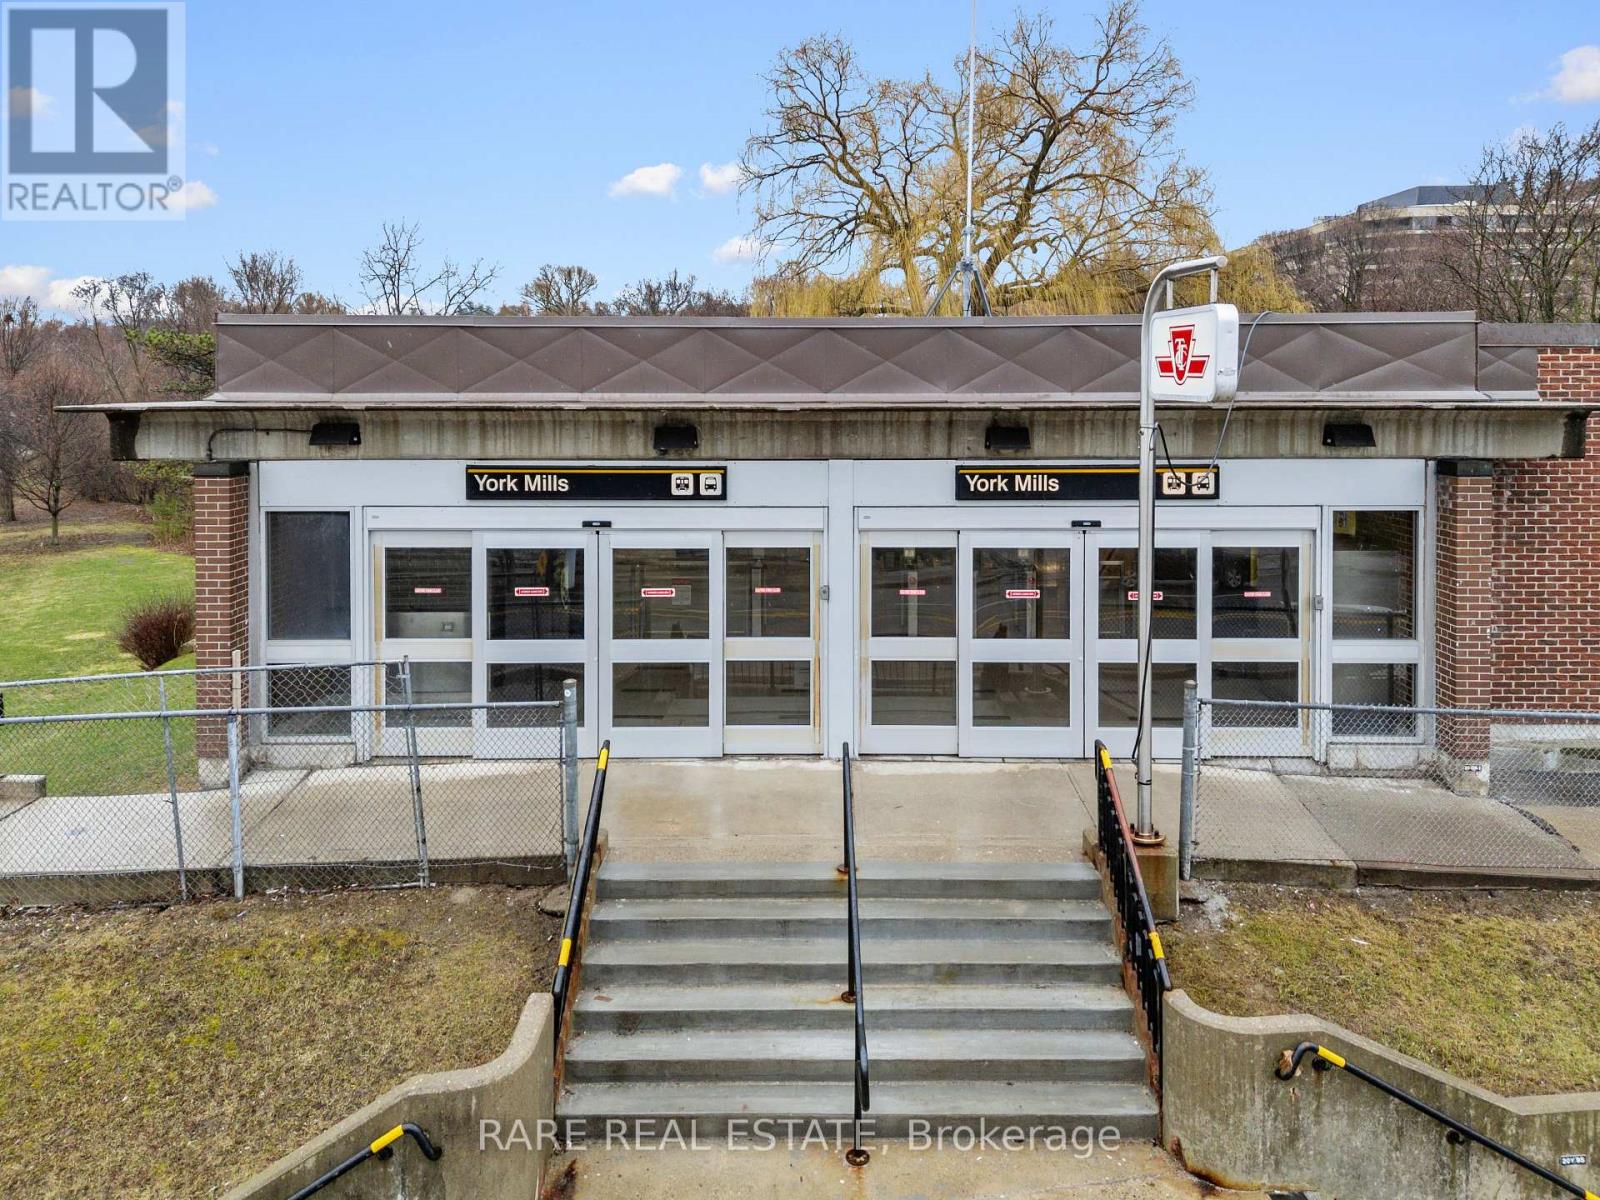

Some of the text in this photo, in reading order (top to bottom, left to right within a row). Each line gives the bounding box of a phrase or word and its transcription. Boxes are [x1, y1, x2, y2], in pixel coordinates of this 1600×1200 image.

[473, 474, 569, 492] York Mills
[965, 474, 1060, 492] York Mills
